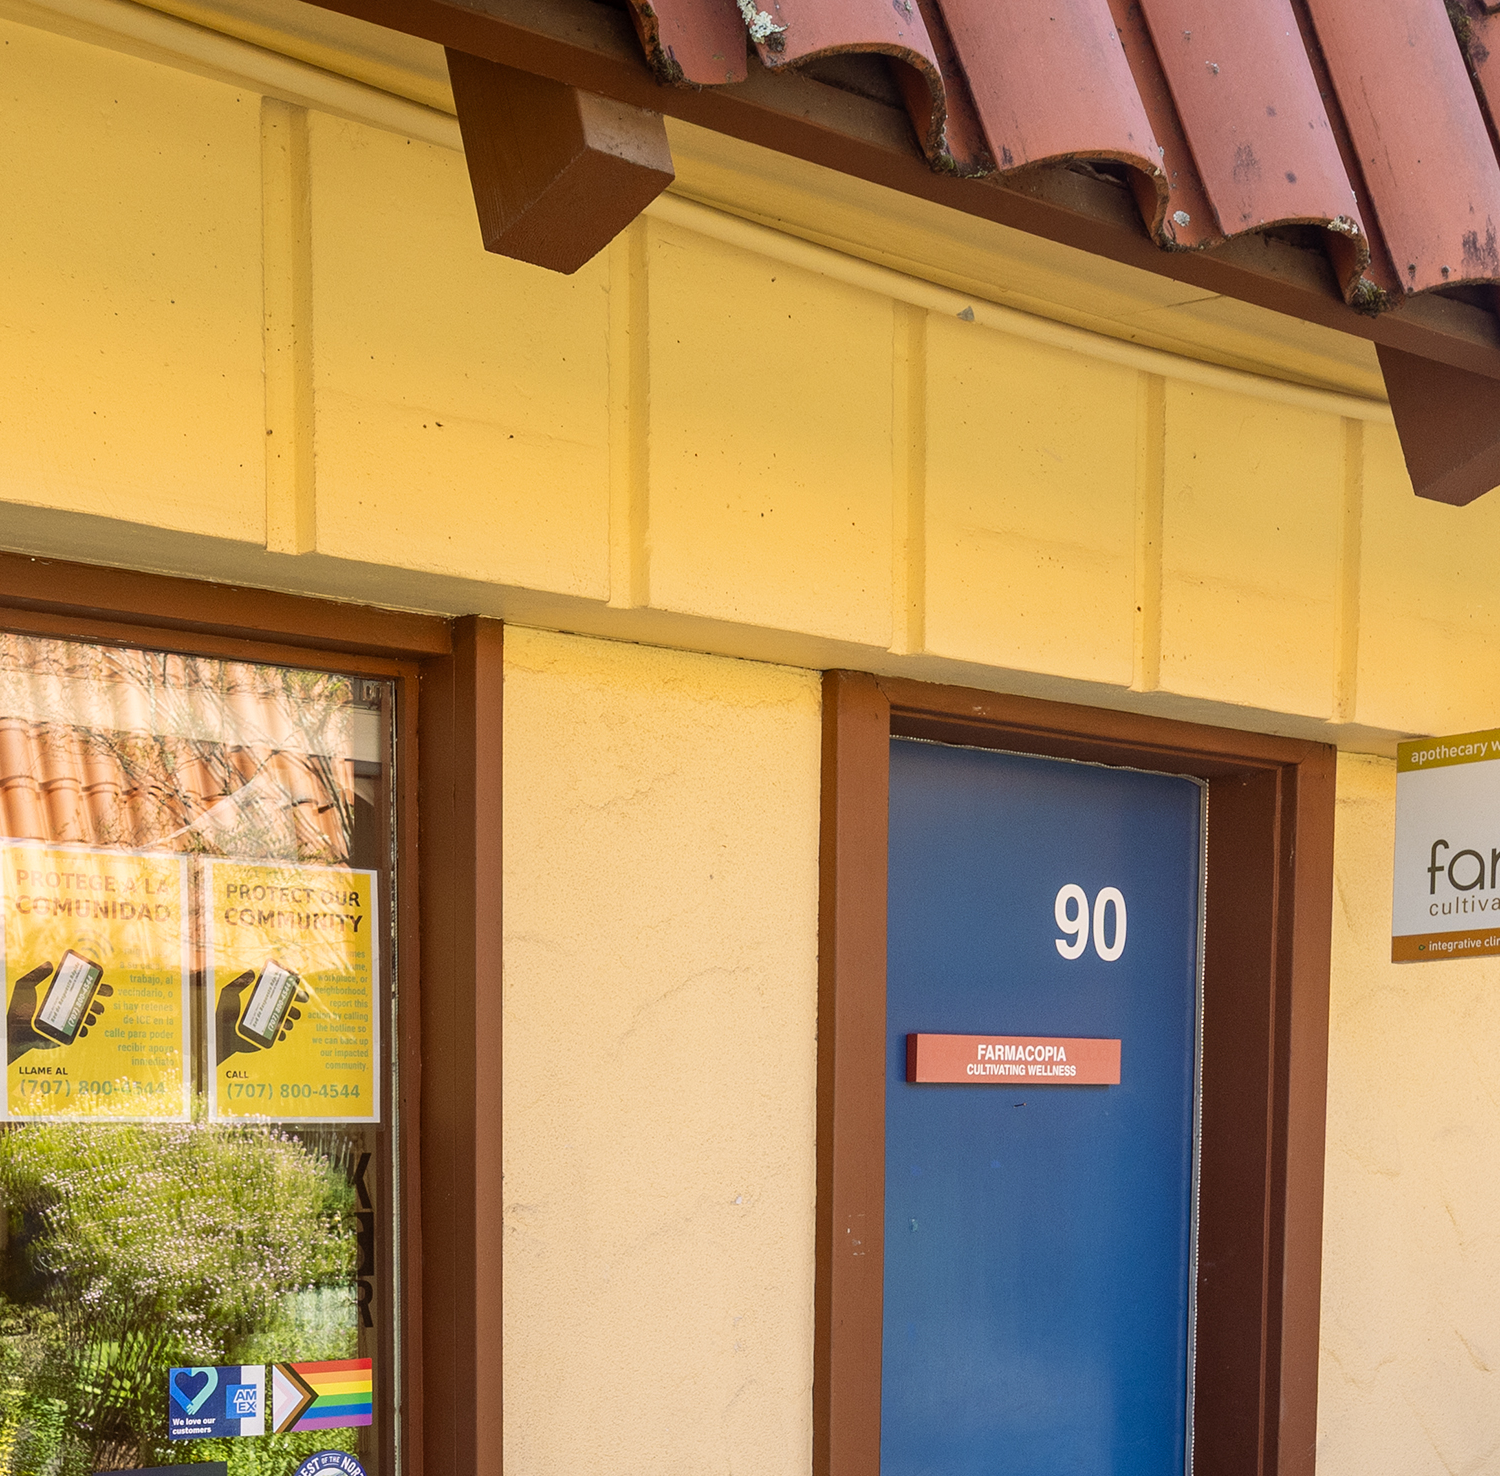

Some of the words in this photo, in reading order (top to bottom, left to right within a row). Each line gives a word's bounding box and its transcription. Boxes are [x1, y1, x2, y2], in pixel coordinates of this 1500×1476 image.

[1411, 740, 1488, 764] apothecary
[16, 869, 116, 892] PROTEGE
[123, 878, 136, 893] A
[145, 879, 170, 895] LA
[226, 884, 314, 903] PROTECT
[321, 890, 360, 907] OUR
[16, 895, 171, 922] COMUNIDAD
[224, 908, 363, 932] COMMUNITY
[1054, 884, 1127, 962] 90
[1429, 936, 1481, 952] integrative
[130, 974, 163, 985] trabajo,
[166, 975, 173, 984] al
[318, 975, 358, 984] workplace,
[118, 989, 167, 999] vecindario,
[315, 987, 368, 996] neighborhood,
[123, 1003, 138, 1012] hay
[355, 999, 368, 1008] this
[123, 1016, 134, 1024] de
[136, 1016, 150, 1024] ICE
[166, 1017, 173, 1025] la
[344, 1013, 368, 1022] calling
[316, 1024, 327, 1032] the
[330, 1024, 356, 1033] hotline
[105, 1028, 125, 1037] calle
[128, 1030, 146, 1040] para
[150, 1030, 173, 1040] poder
[118, 1044, 145, 1052] recibir
[149, 1045, 174, 1054] apoyo
[334, 1049, 368, 1058] impacted
[977, 1044, 1066, 1062] FARMACOPIA
[131, 1058, 174, 1066] inmediato
[325, 1062, 368, 1071] community.
[19, 1067, 52, 1075] LLAME
[55, 1067, 68, 1075] AL
[966, 1063, 1026, 1076] CULTIVATING
[1028, 1064, 1076, 1076] WELLNESS
[20, 1079, 71, 1097] (707)
[78, 1080, 165, 1095] 800-4544
[227, 1084, 273, 1100] (707)
[280, 1084, 360, 1099] 800-4544
[236, 1389, 257, 1400] AM
[237, 1401, 256, 1412] EX
[173, 1418, 184, 1426] We
[186, 1417, 201, 1425] love
[173, 1427, 211, 1435] customers
